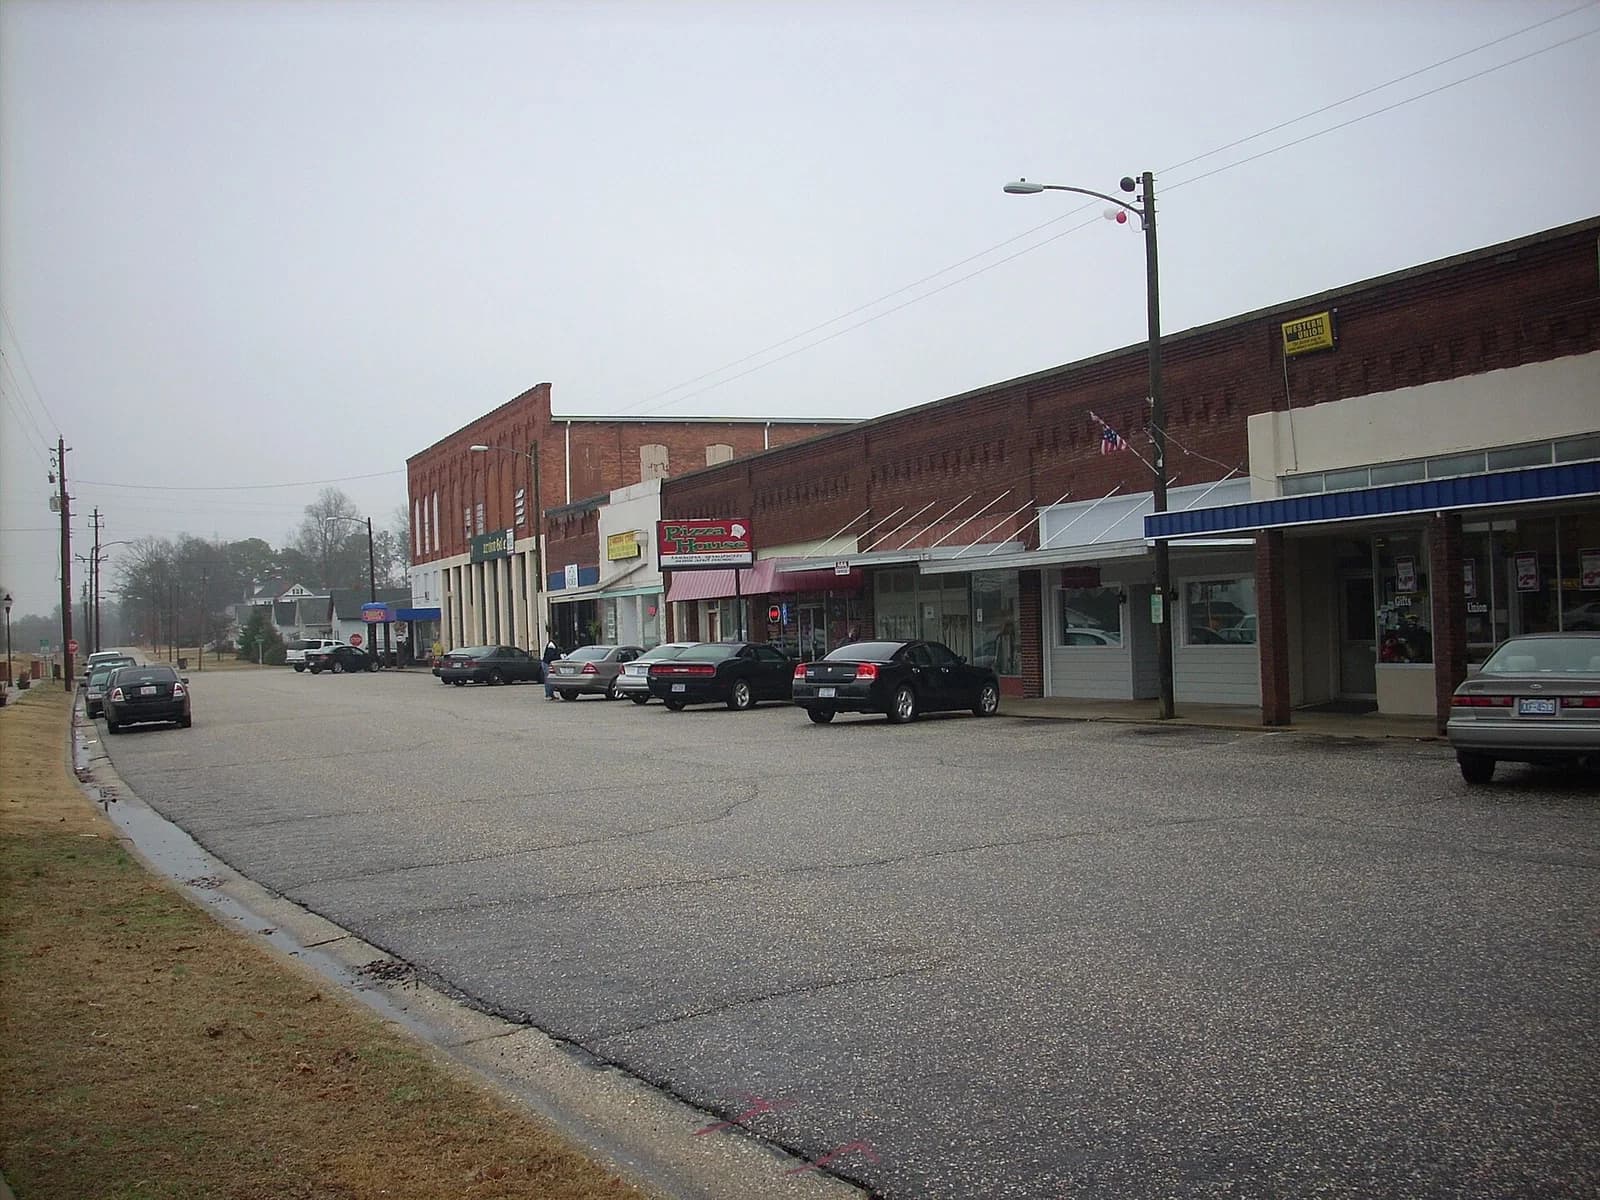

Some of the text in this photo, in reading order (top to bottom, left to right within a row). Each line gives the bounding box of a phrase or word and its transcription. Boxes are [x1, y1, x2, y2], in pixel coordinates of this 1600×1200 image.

[1286, 318, 1323, 335] WESTERN
[1297, 326, 1324, 339] UNION
[664, 524, 728, 542] Pizza
[675, 537, 748, 554] House
[1395, 596, 1412, 607] Gifts
[1467, 602, 1488, 613] Union
